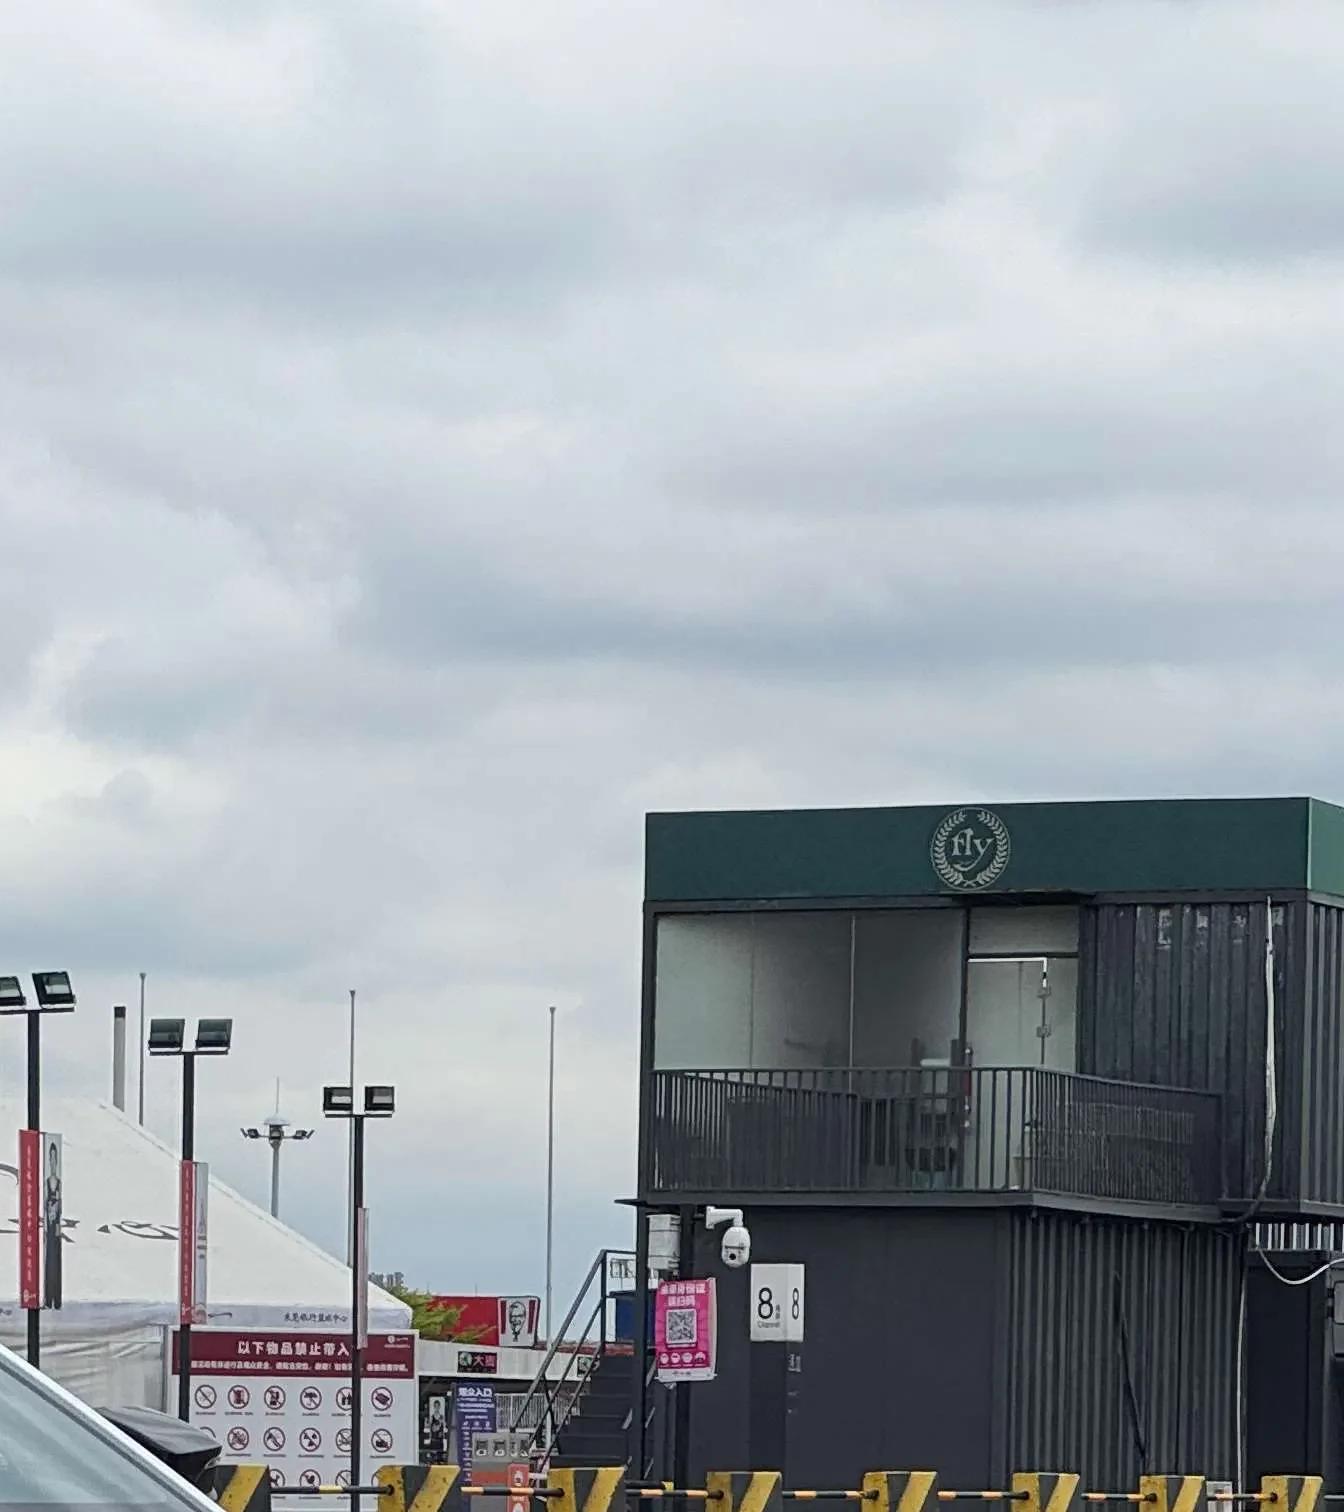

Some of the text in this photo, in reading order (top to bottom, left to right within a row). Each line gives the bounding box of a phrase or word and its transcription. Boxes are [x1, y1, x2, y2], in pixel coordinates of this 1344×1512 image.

[952, 828, 995, 872] fly
[757, 1287, 774, 1320] 8
[792, 1288, 800, 1320] 8
[237, 1340, 350, 1357] 以下物品禁止带入
